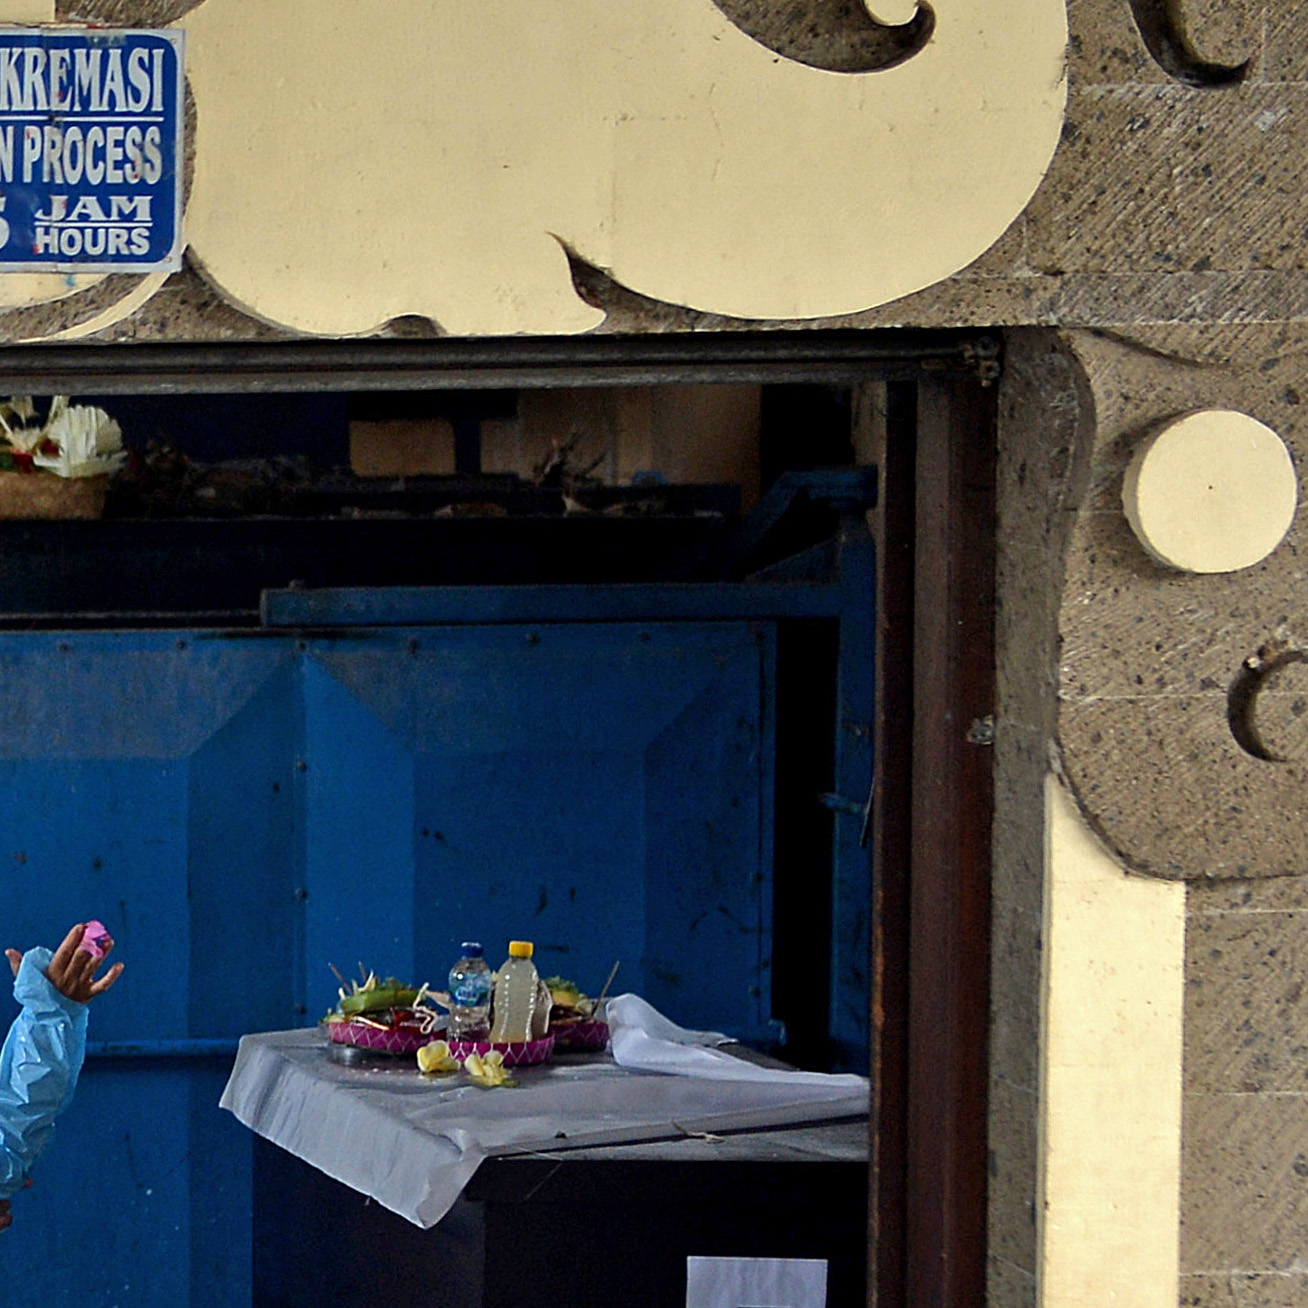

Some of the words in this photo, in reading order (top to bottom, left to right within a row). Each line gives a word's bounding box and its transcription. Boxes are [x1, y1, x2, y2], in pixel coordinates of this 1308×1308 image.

[23, 127, 163, 185] PROCESS
[34, 195, 153, 222] JAM
[35, 227, 150, 256] HOURS
